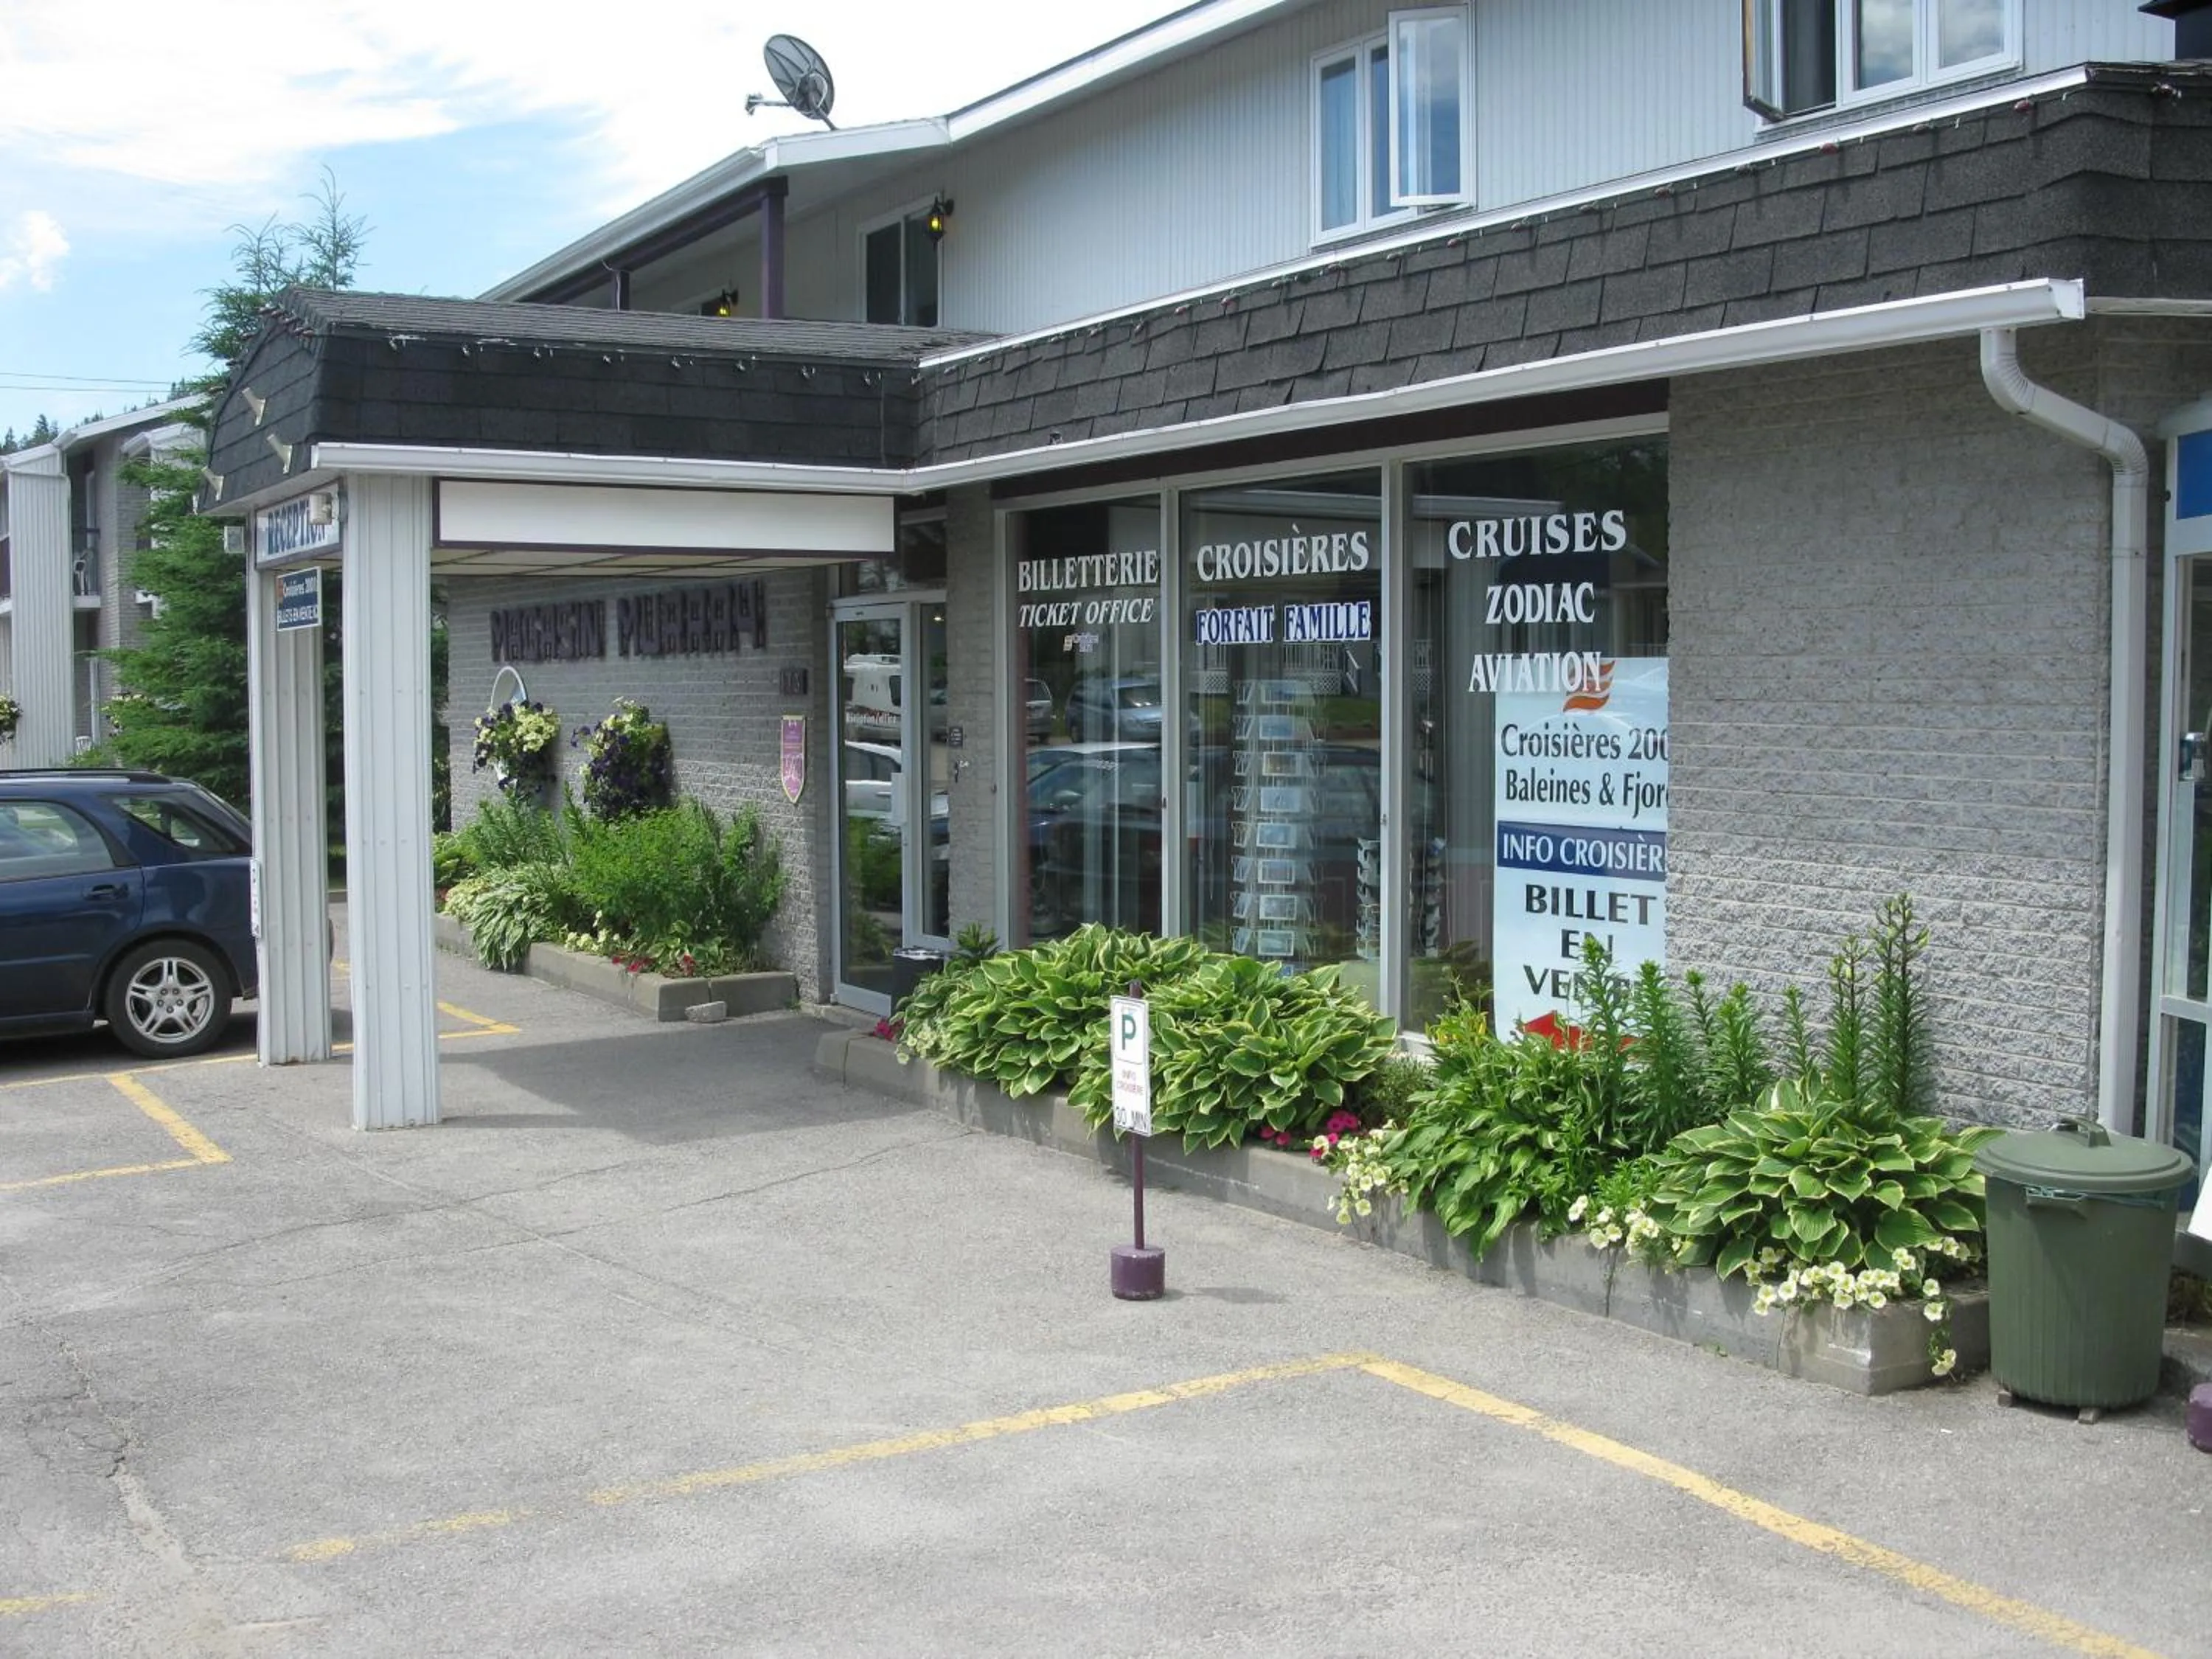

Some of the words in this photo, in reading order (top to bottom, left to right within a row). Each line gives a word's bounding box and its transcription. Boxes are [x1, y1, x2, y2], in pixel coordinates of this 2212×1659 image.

[1196, 524, 1369, 582] CROISIÈRES
[1447, 509, 1627, 560] CRUISES
[1018, 549, 1158, 592] BILLETTERIE
[1018, 602, 1081, 628] TICKET
[1085, 598, 1154, 625] OFFICE
[1194, 605, 1275, 645] FORFAIT
[1283, 601, 1372, 642] FAMILLE
[1486, 582, 1595, 625] ZODIAC
[1468, 651, 1601, 692] AVIATION
[1500, 722, 1621, 760] Croisières
[1506, 768, 1590, 805] Baleines
[1599, 772, 1615, 806] &
[1623, 771, 1668, 818] Fjor
[1503, 833, 1554, 863] INFO
[1559, 834, 1667, 873] CROISIÈR
[1526, 883, 1657, 926] BILLET
[1121, 1014, 1137, 1051] P
